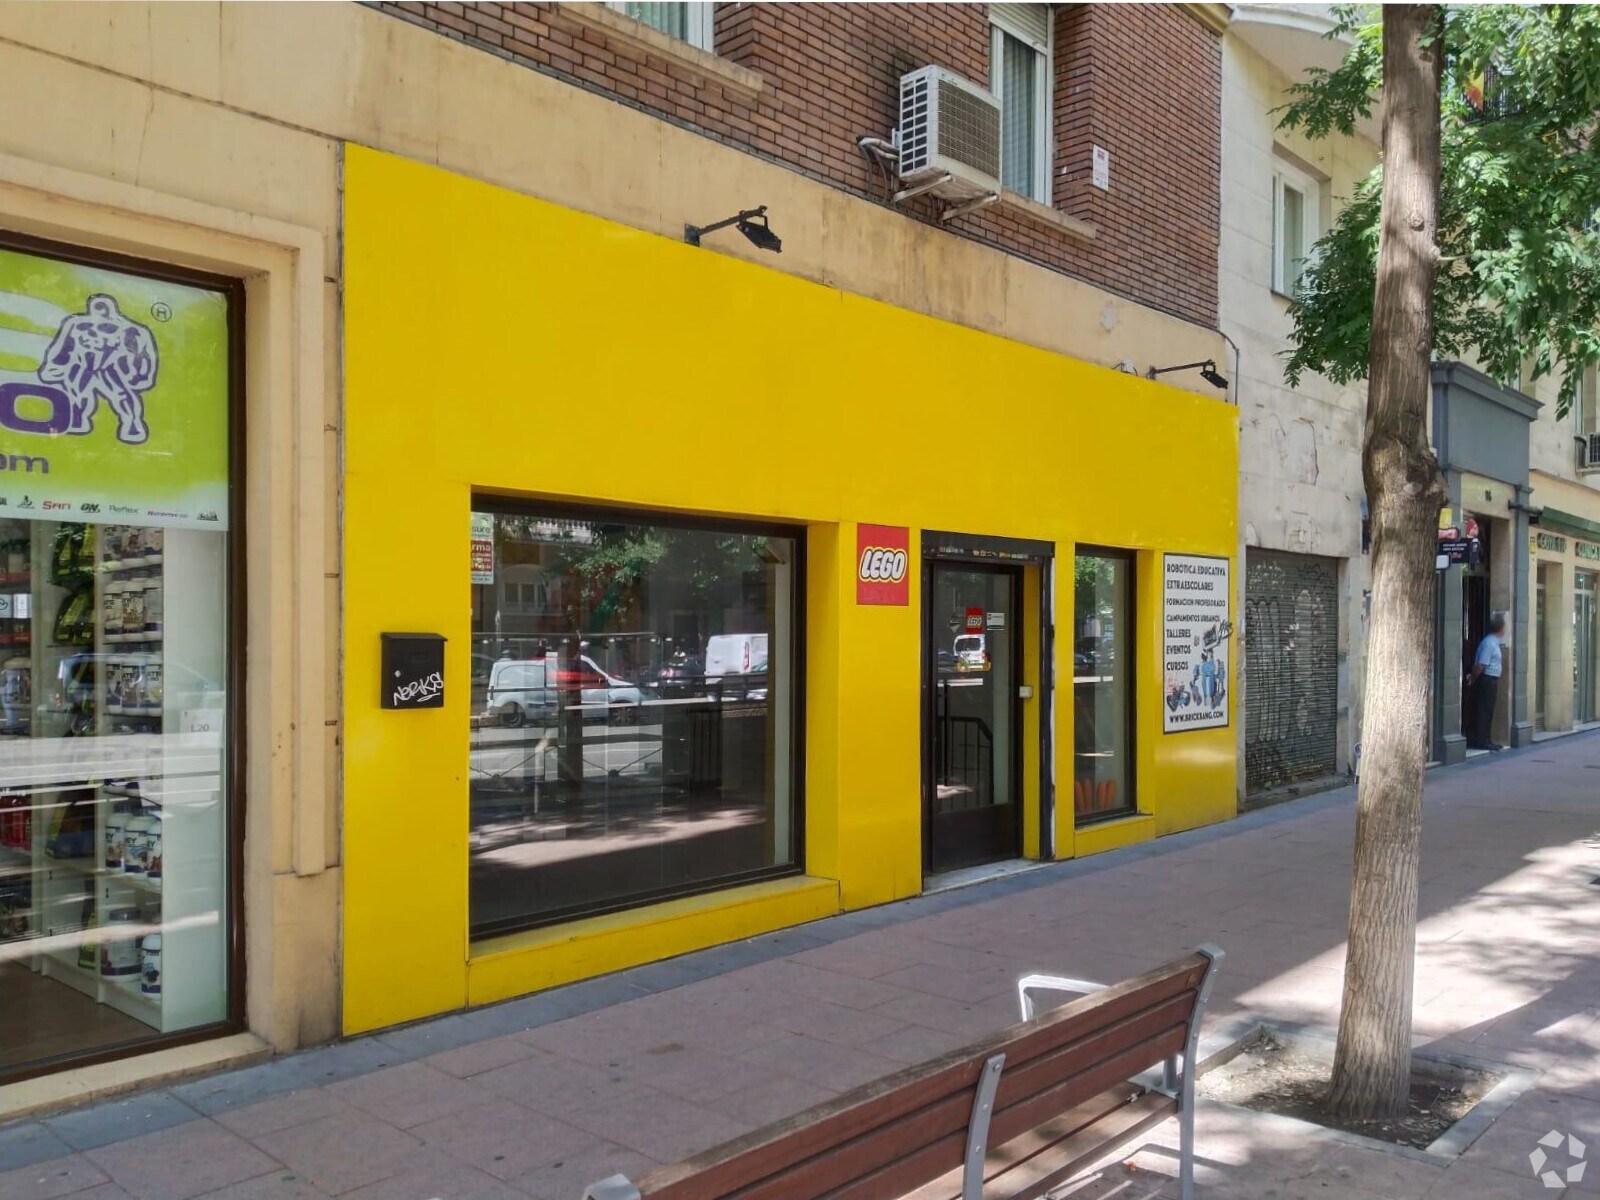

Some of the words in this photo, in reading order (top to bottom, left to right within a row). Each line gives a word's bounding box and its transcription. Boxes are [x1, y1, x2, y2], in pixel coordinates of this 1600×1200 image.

[861, 549, 905, 580] LEGO
[1198, 566, 1226, 576] EDUCATIVA
[1167, 580, 1214, 591] EXTRAESCOLARES
[1195, 599, 1226, 607] PROFESORADO
[967, 616, 982, 627] LEGO
[1166, 629, 1191, 638] TALLERES
[1166, 645, 1191, 655] EVENTOS
[1166, 662, 1189, 671] CURSOS
